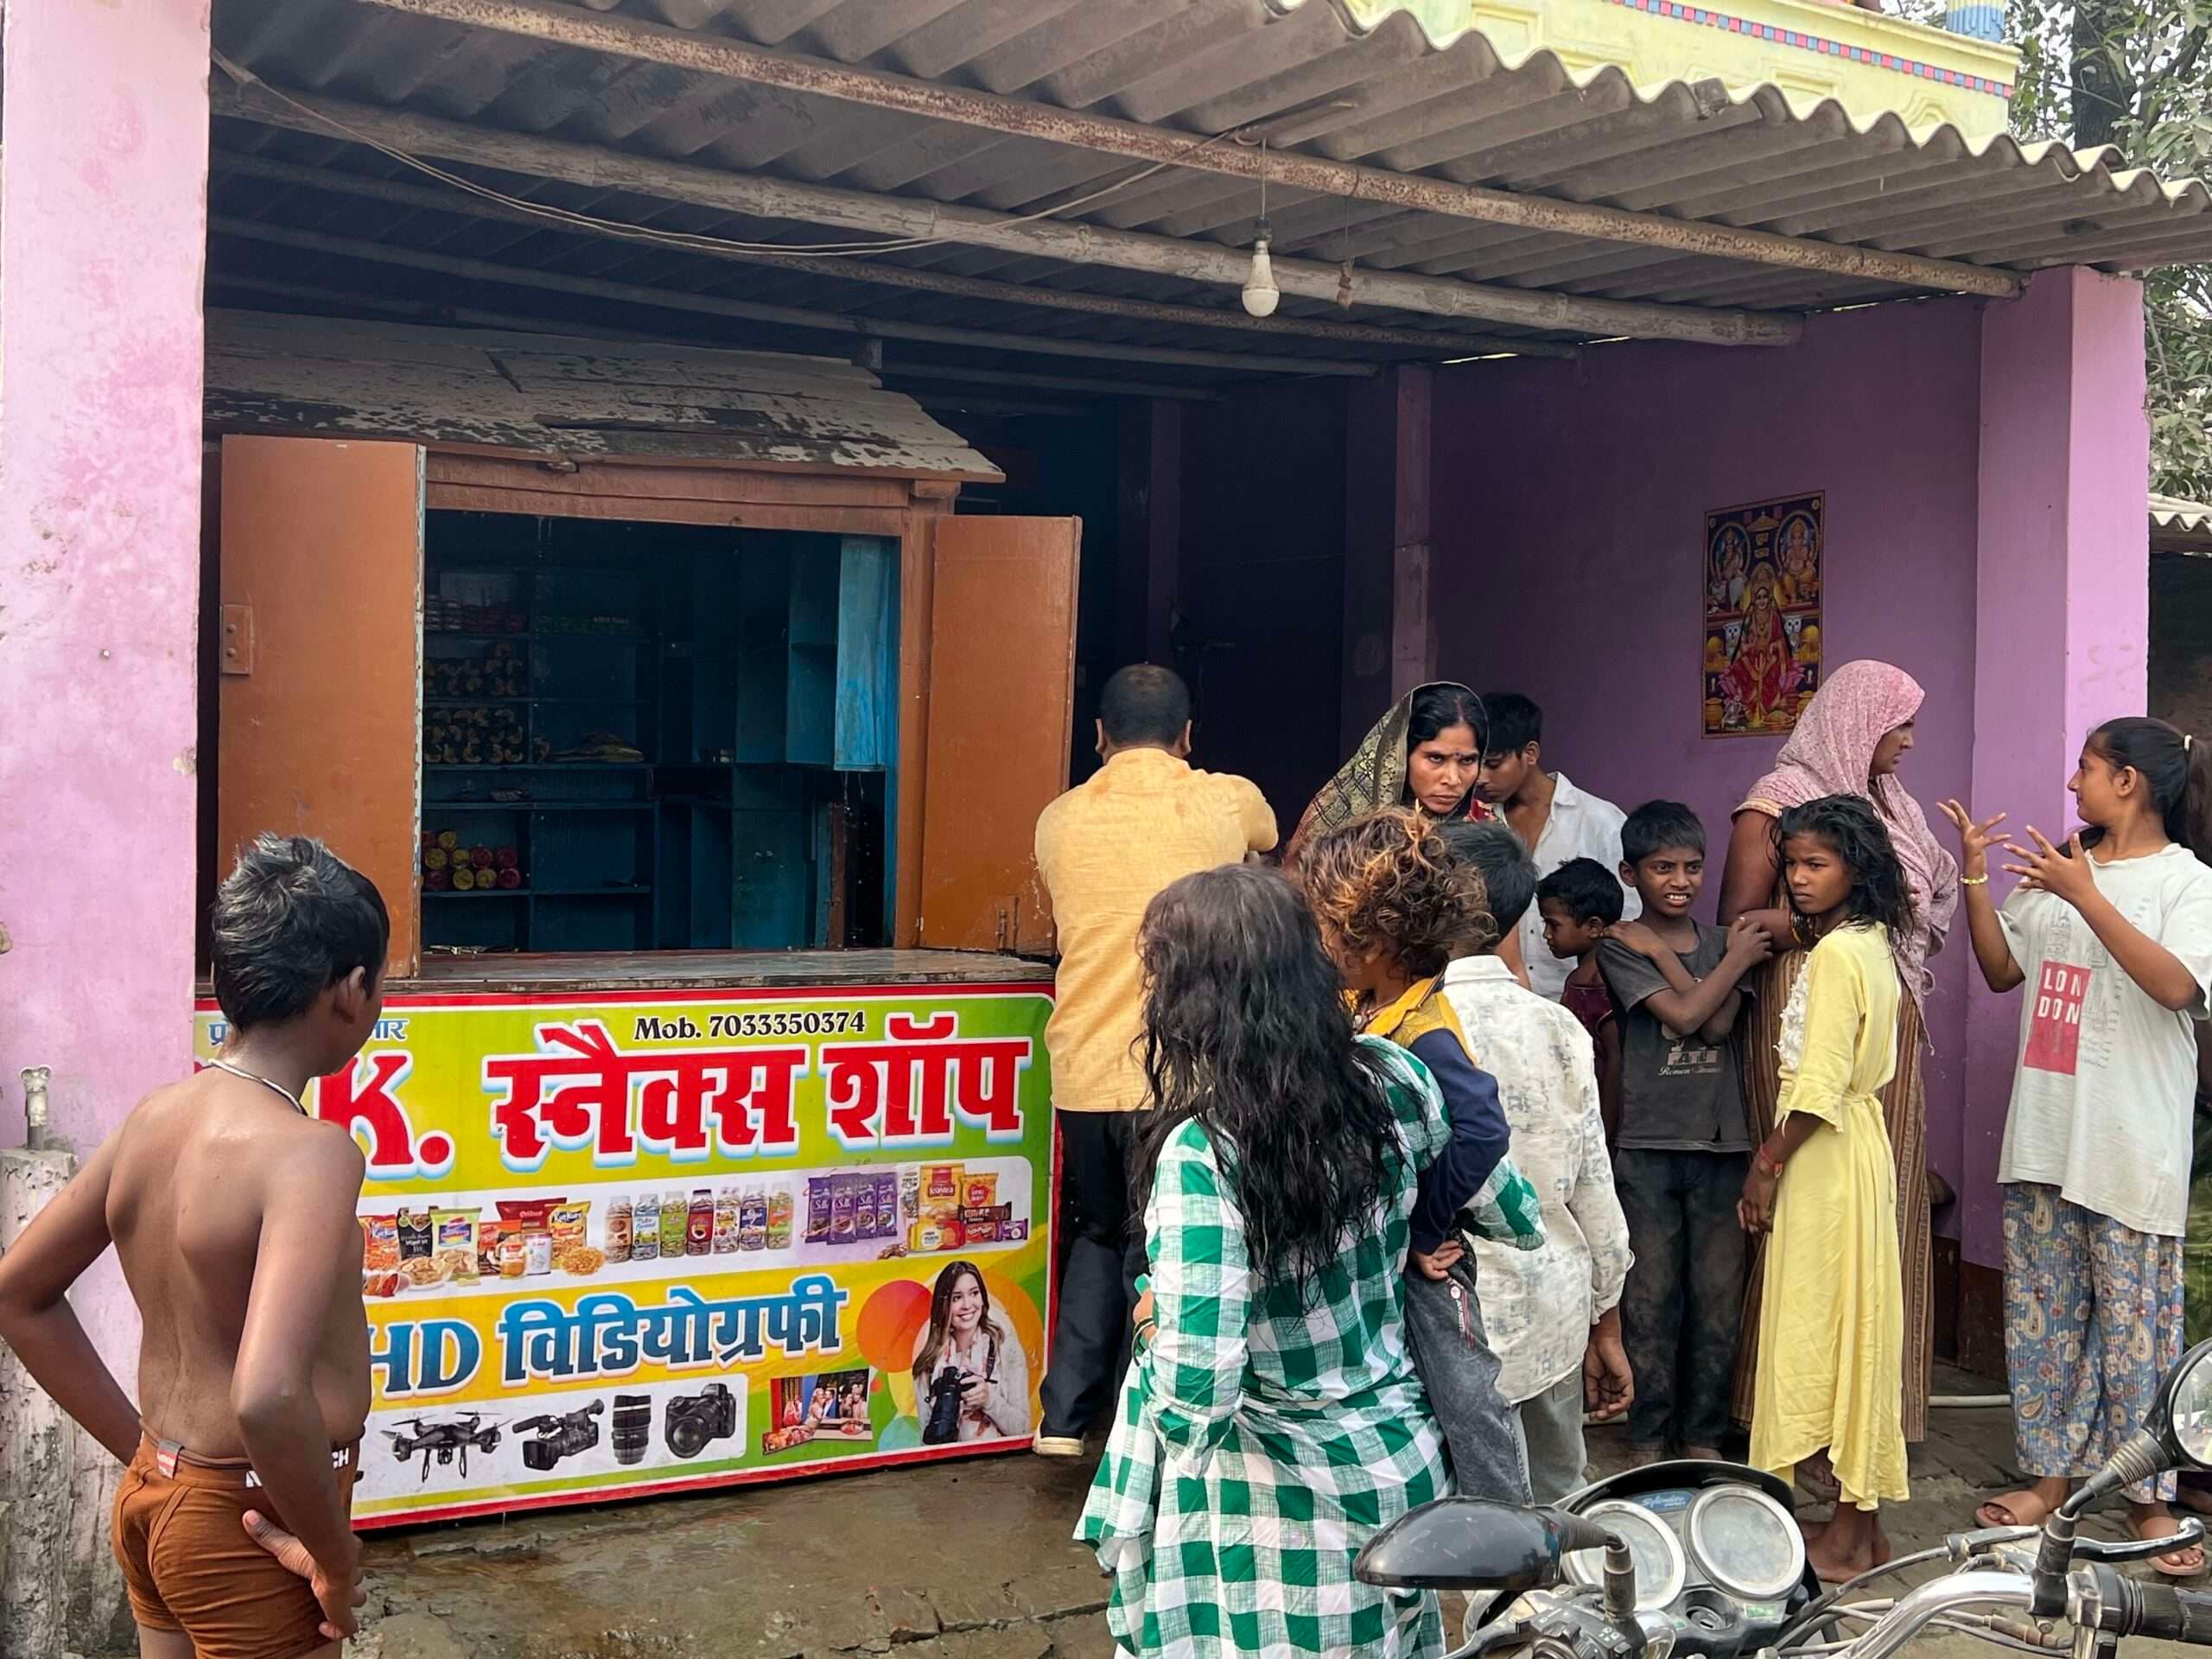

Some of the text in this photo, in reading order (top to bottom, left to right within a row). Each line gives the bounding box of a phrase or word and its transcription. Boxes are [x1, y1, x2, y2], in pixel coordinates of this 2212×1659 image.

[2044, 968, 2082, 997] LON
[633, 1010, 866, 1040] Mob. 7033350374
[2037, 995, 2081, 1026] DON
[486, 1023, 807, 1159] स्नैक्स
[823, 1014, 1031, 1139] शॉप
